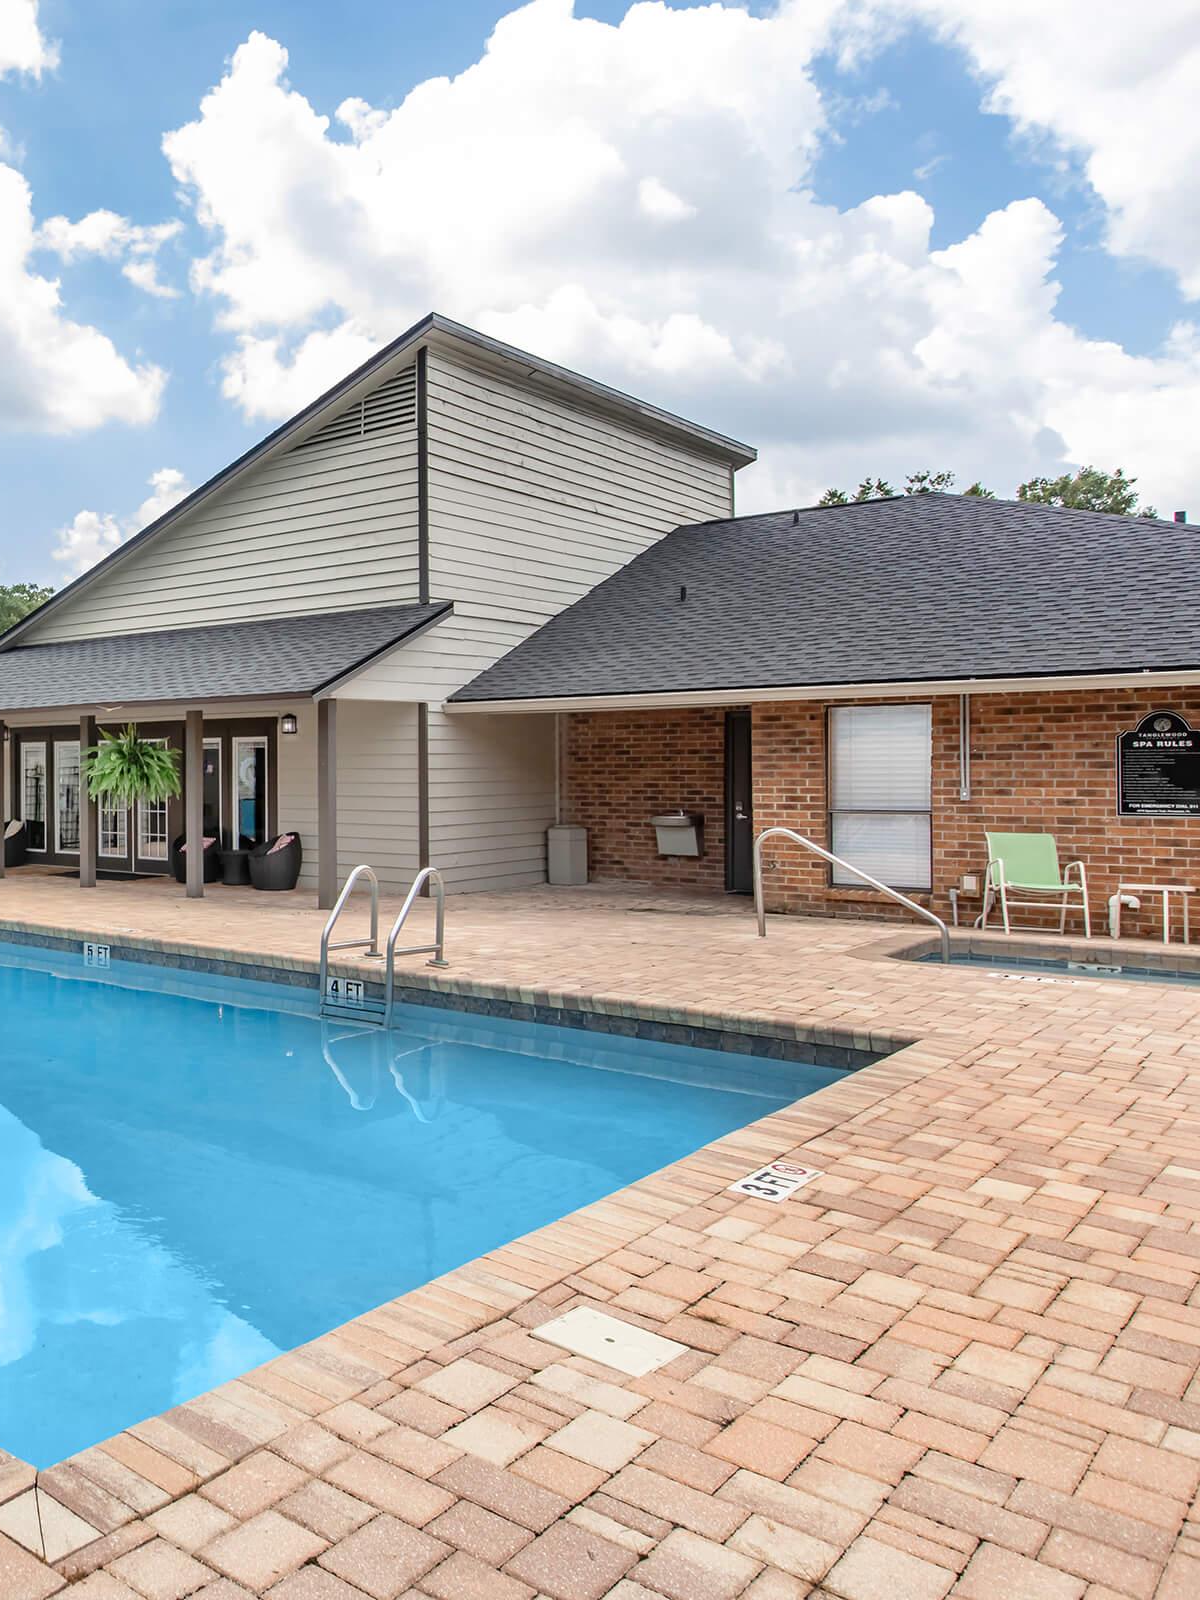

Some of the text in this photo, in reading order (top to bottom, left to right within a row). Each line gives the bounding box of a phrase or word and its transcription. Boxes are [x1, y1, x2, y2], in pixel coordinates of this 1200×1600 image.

[97, 946, 109, 958] FT
[331, 980, 362, 996] 4 FT
[741, 1171, 799, 1196] 3 FT
